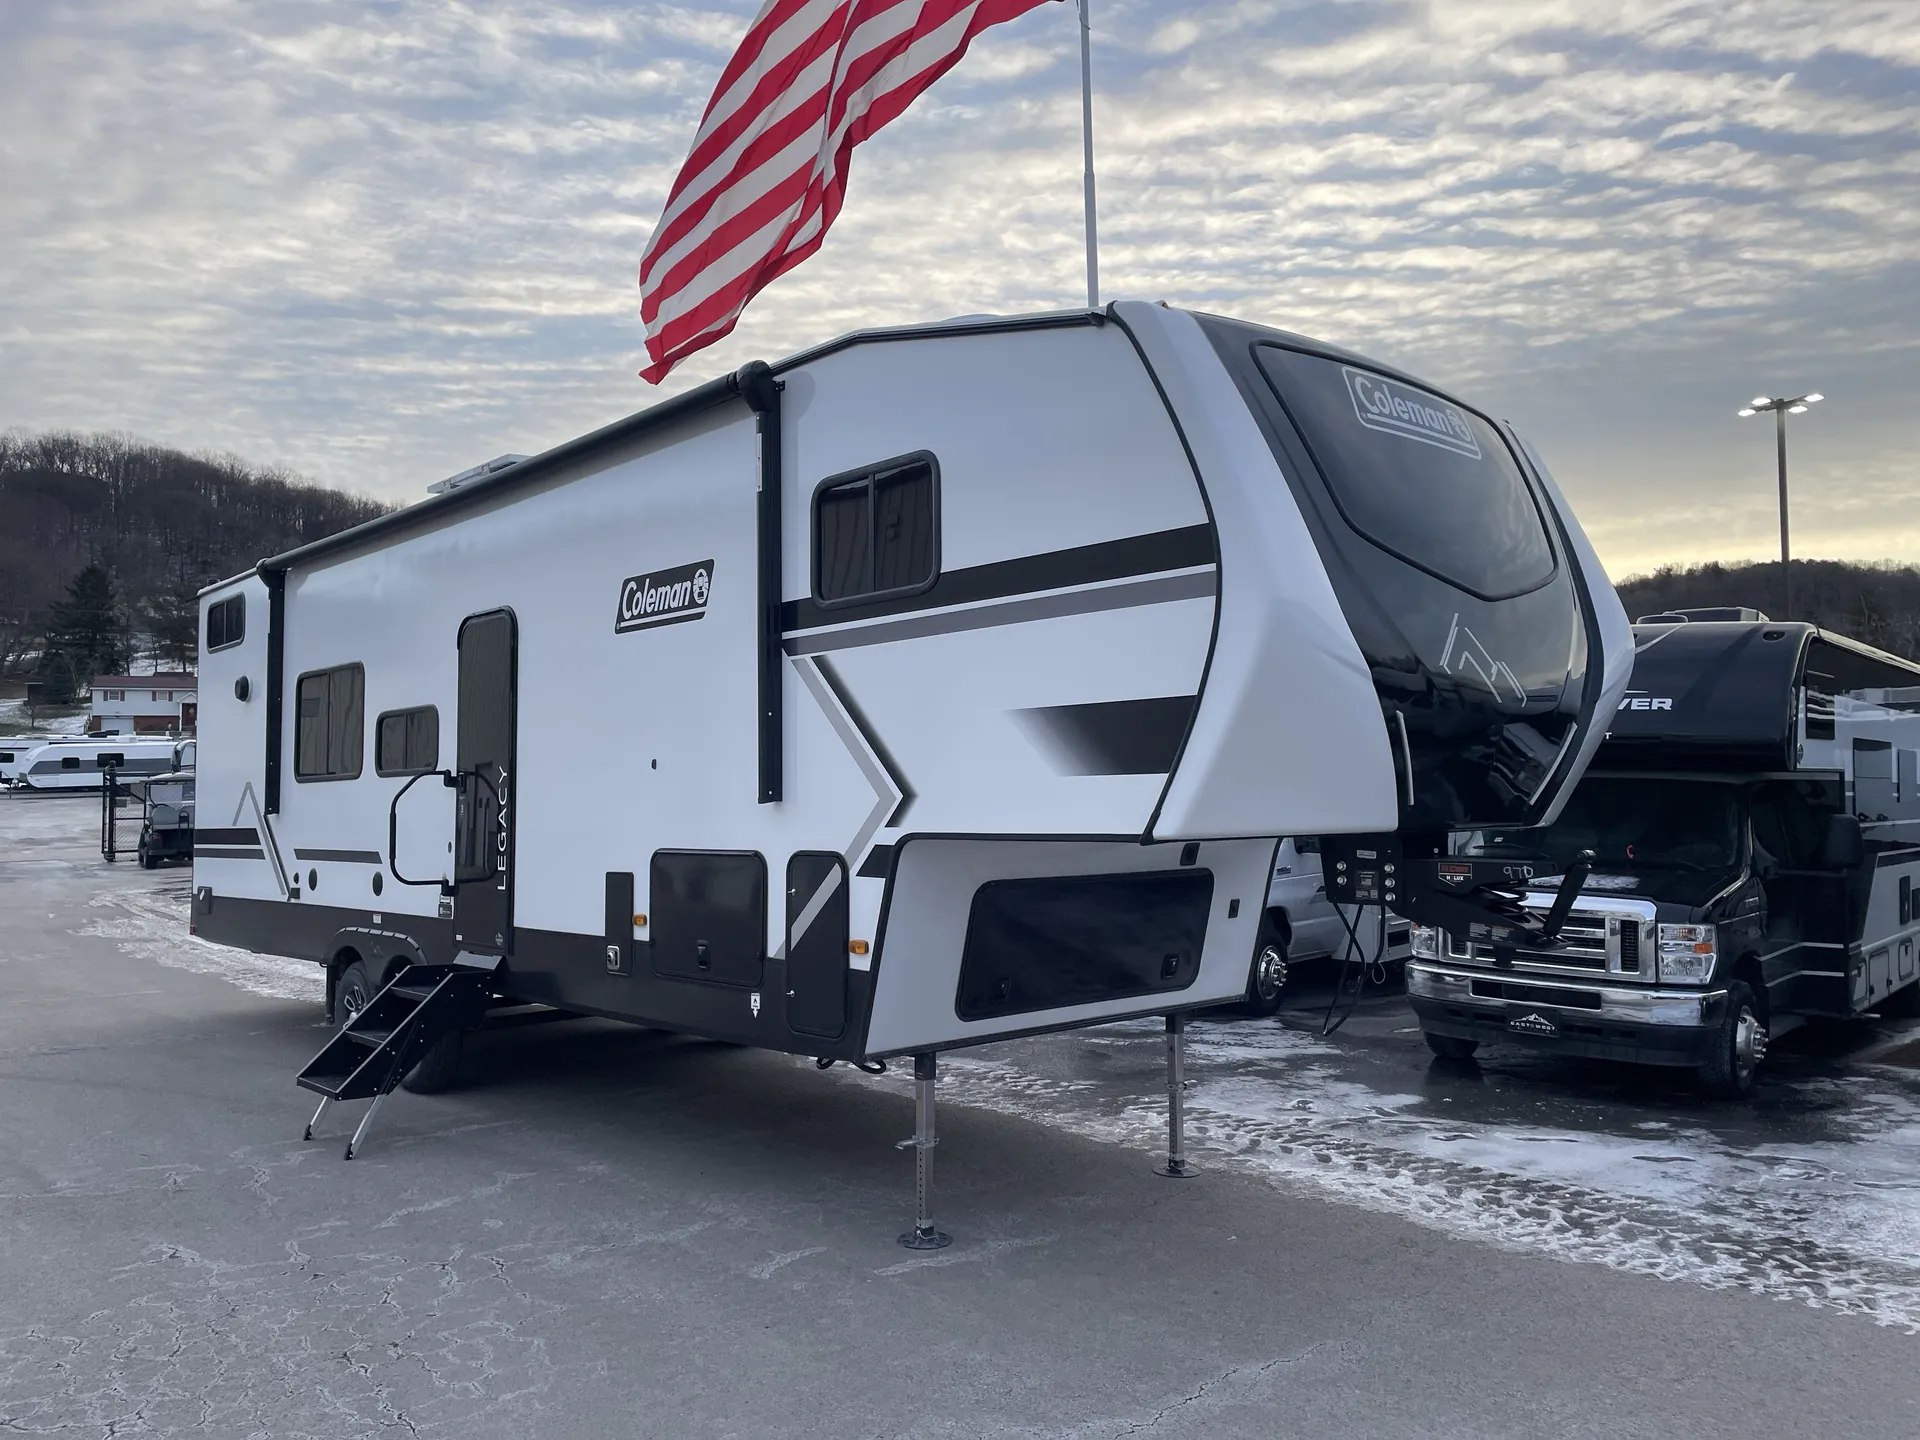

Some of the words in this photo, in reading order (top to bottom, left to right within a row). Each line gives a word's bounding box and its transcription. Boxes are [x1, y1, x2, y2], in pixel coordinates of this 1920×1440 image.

[1354, 375, 1453, 435] Coleman
[622, 578, 691, 620] Coleman
[497, 765, 508, 890] LEGACY
